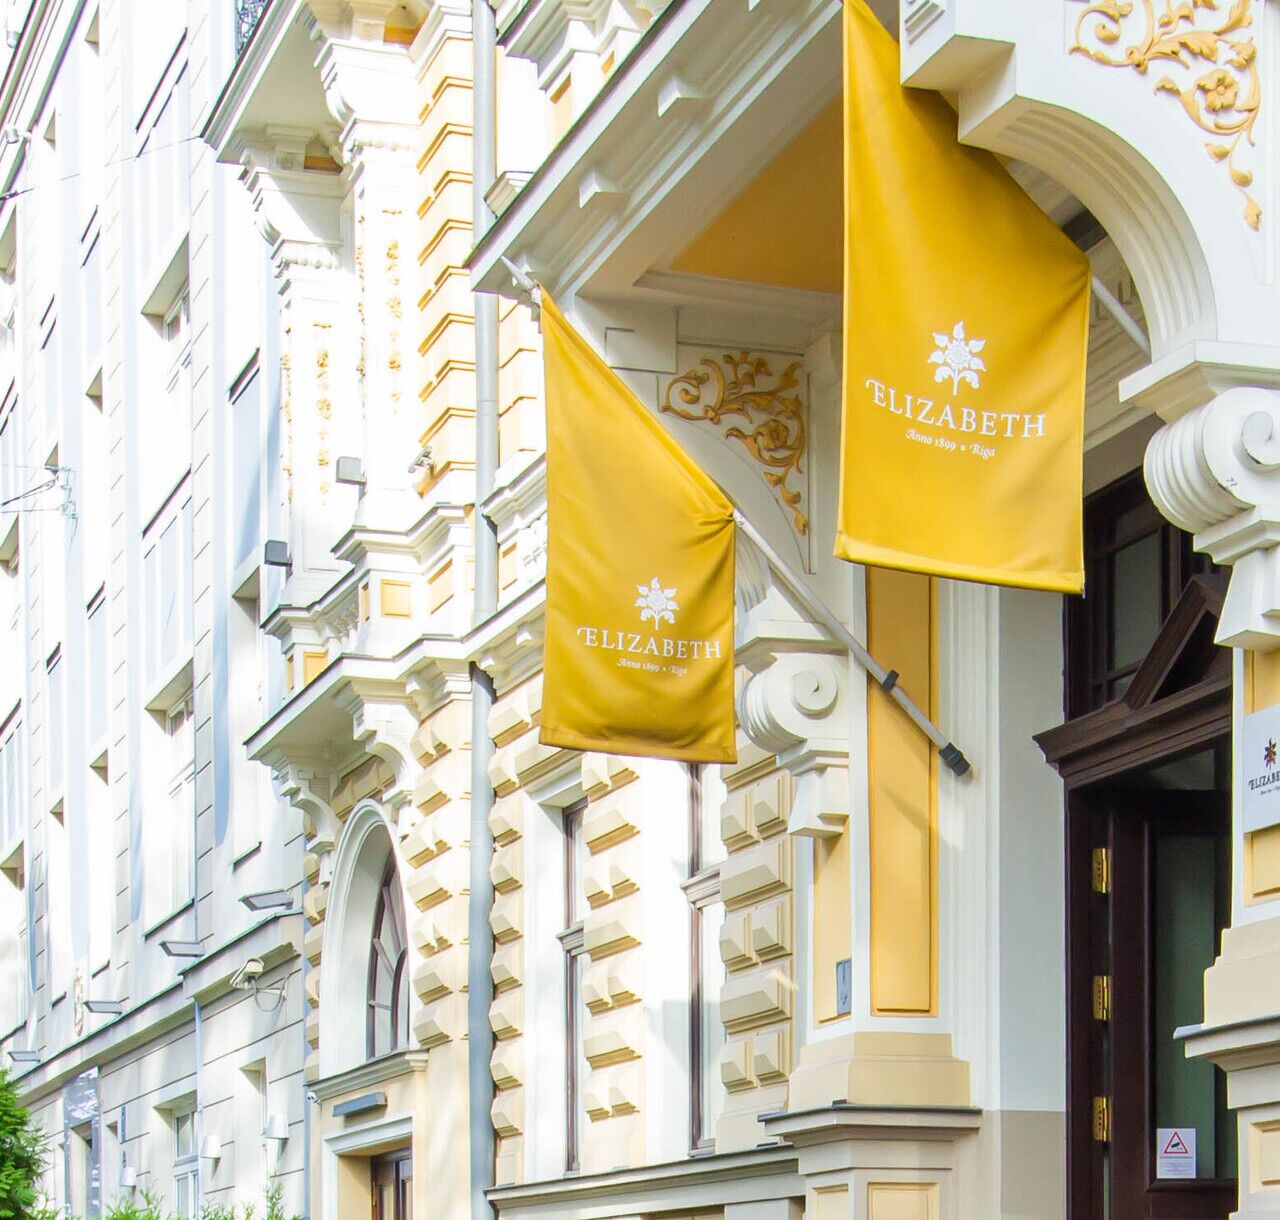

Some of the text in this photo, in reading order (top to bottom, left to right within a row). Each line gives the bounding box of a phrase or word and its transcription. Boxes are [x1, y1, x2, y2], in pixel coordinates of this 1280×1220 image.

[866, 379, 1045, 437] ELIZABETH
[906, 429, 932, 444] Anno
[935, 438, 956, 451] 1899
[577, 627, 721, 658] ELIZABETH
